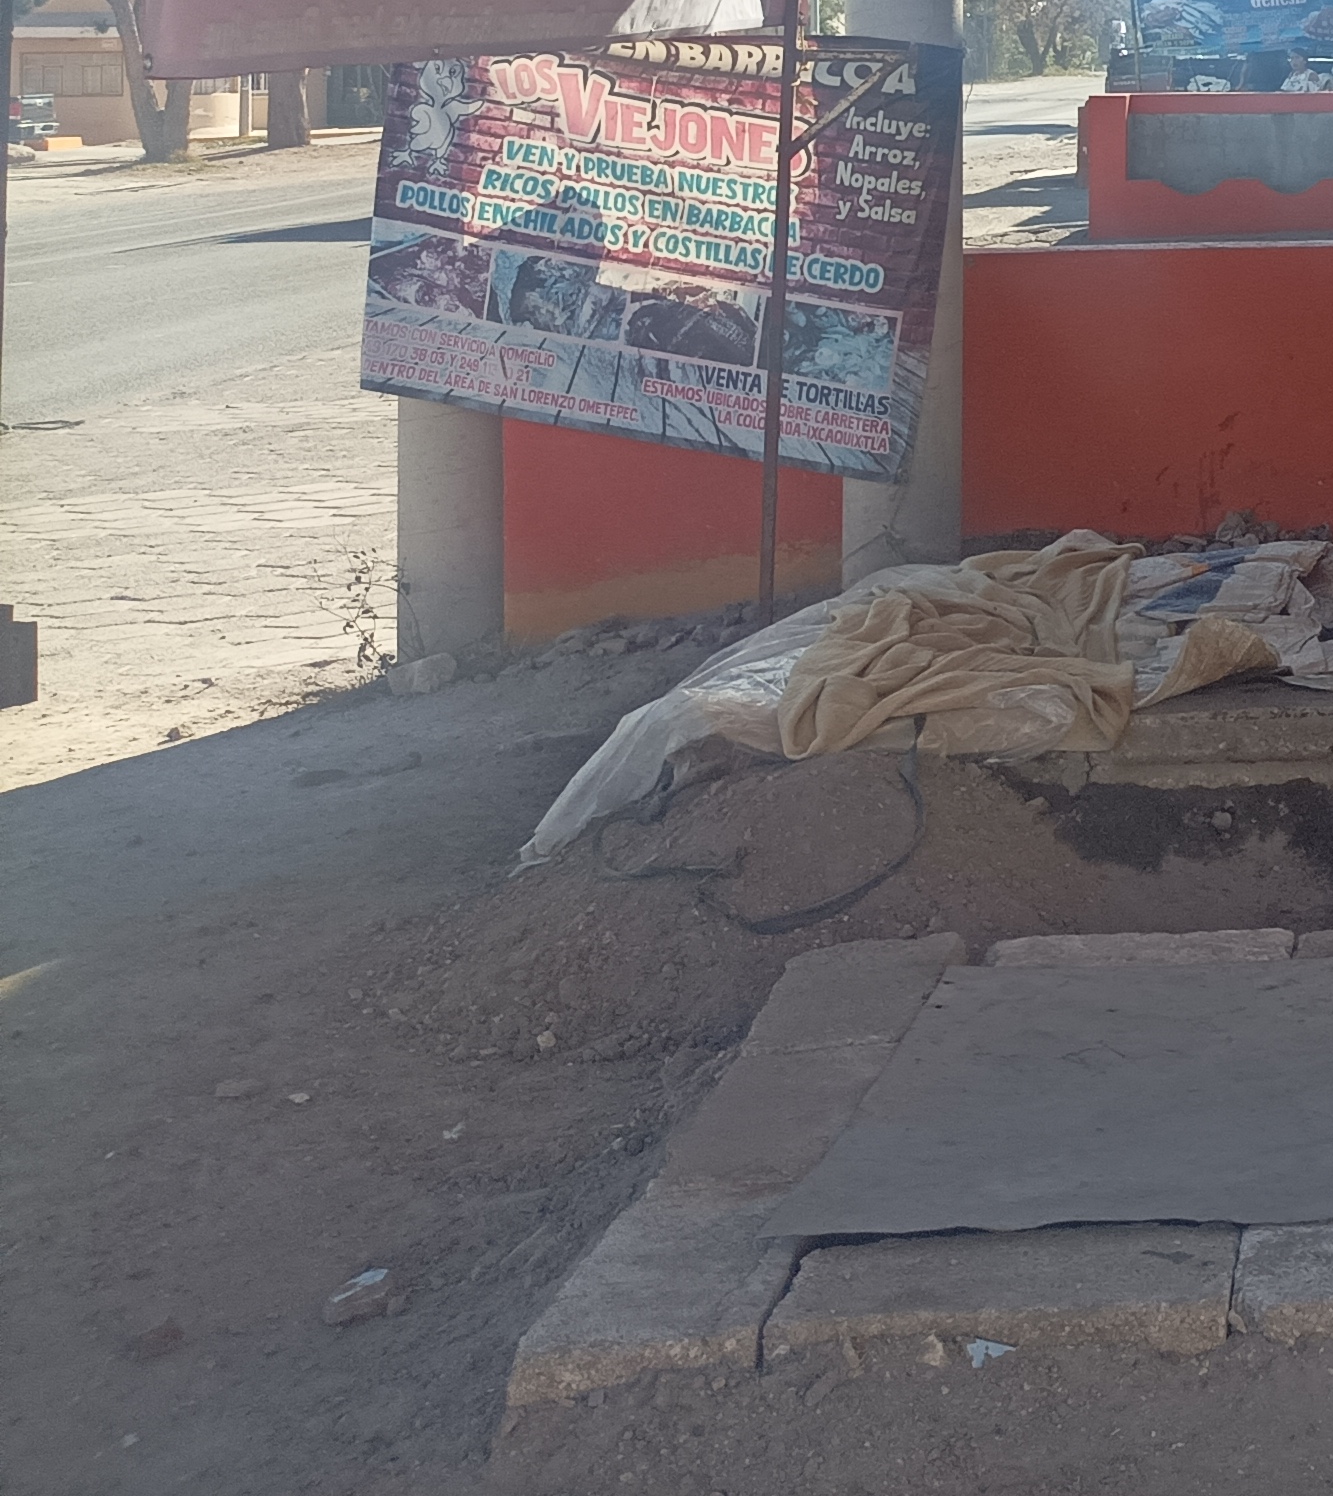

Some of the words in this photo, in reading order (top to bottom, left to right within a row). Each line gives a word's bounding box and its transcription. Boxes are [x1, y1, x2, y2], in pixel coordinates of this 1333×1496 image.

[494, 57, 557, 99] LOS
[845, 106, 931, 141] Incluye:
[505, 140, 555, 166] VEN
[564, 150, 579, 172] Y
[582, 156, 669, 189] PRUEBA
[678, 169, 795, 207] NUESTRO
[848, 134, 920, 171] Arroz,
[484, 168, 556, 201] RICOS
[563, 185, 641, 218] POLLOS
[648, 197, 680, 224] EN
[836, 160, 926, 201] Nopales,
[835, 200, 852, 220] y
[857, 194, 917, 224] Salsa
[400, 186, 472, 219] POLLOS
[478, 201, 622, 247] ENCHILADOS
[631, 226, 647, 249] Y
[653, 231, 763, 273] COSTILLAS
[806, 257, 883, 291] CERDO
[417, 368, 441, 385] DEL
[478, 379, 492, 394] DE
[520, 386, 577, 410] LORENZO
[643, 379, 704, 403] ESTAMOS
[779, 402, 812, 422] OBRE
[814, 408, 890, 436] CARRETERA
[704, 364, 763, 395] VENTA
[796, 380, 891, 416] TORTILLAS
[716, 409, 733, 424] LA
